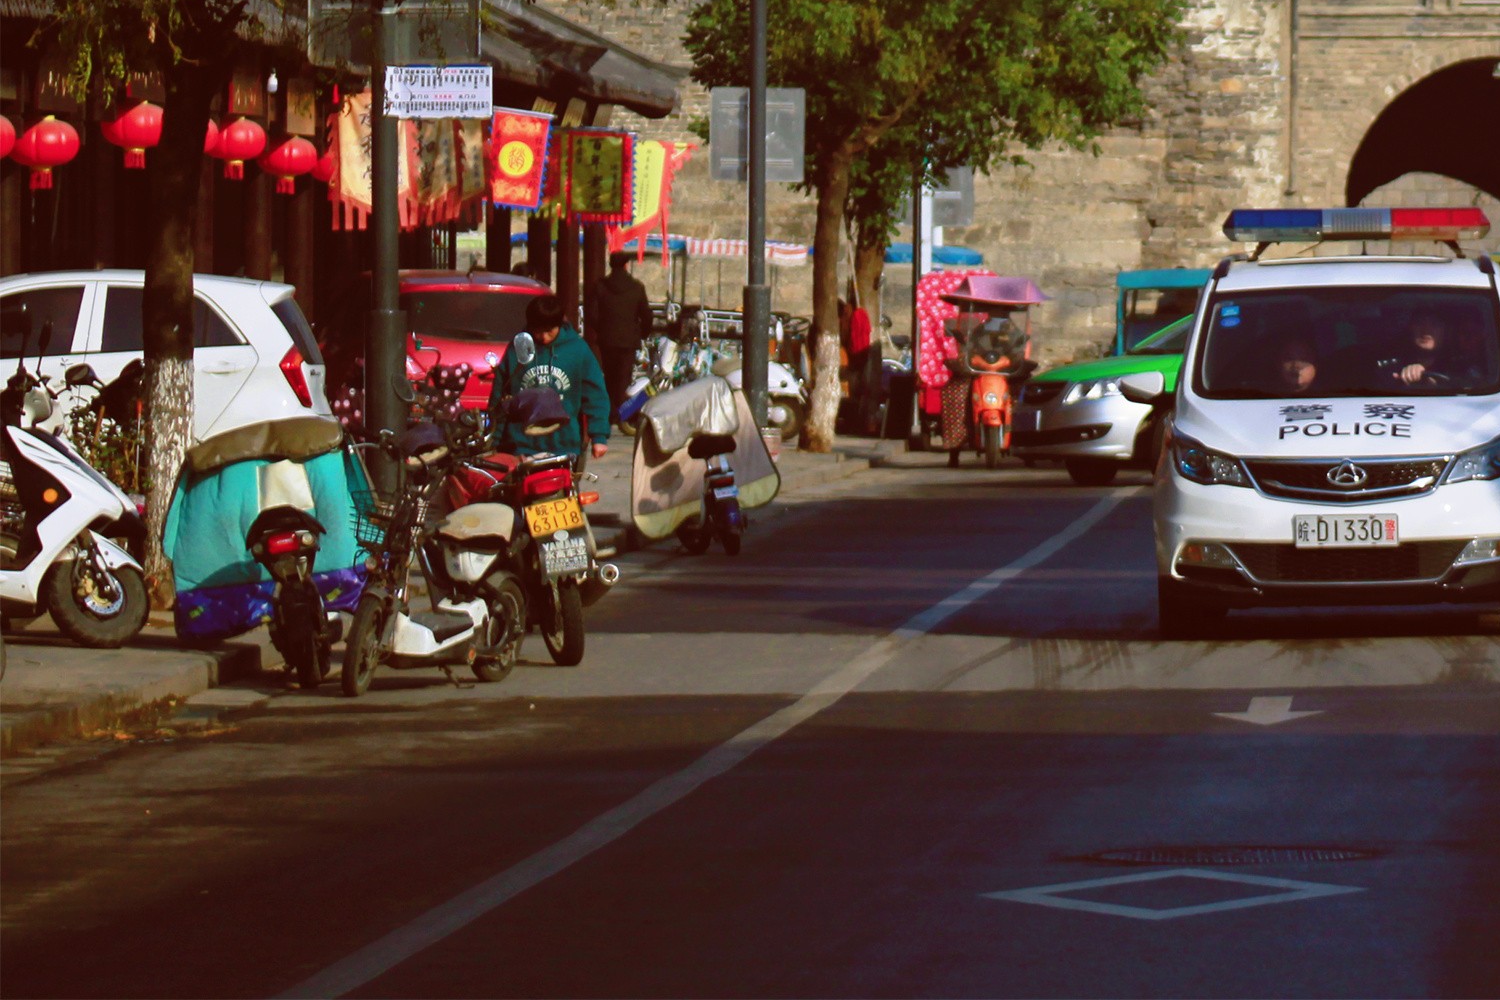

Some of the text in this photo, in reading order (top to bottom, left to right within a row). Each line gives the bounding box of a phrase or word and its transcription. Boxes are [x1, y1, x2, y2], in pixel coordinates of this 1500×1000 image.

[1279, 403, 1415, 422] 警察
[1279, 422, 1411, 439] POLICE
[533, 511, 580, 533] 63118
